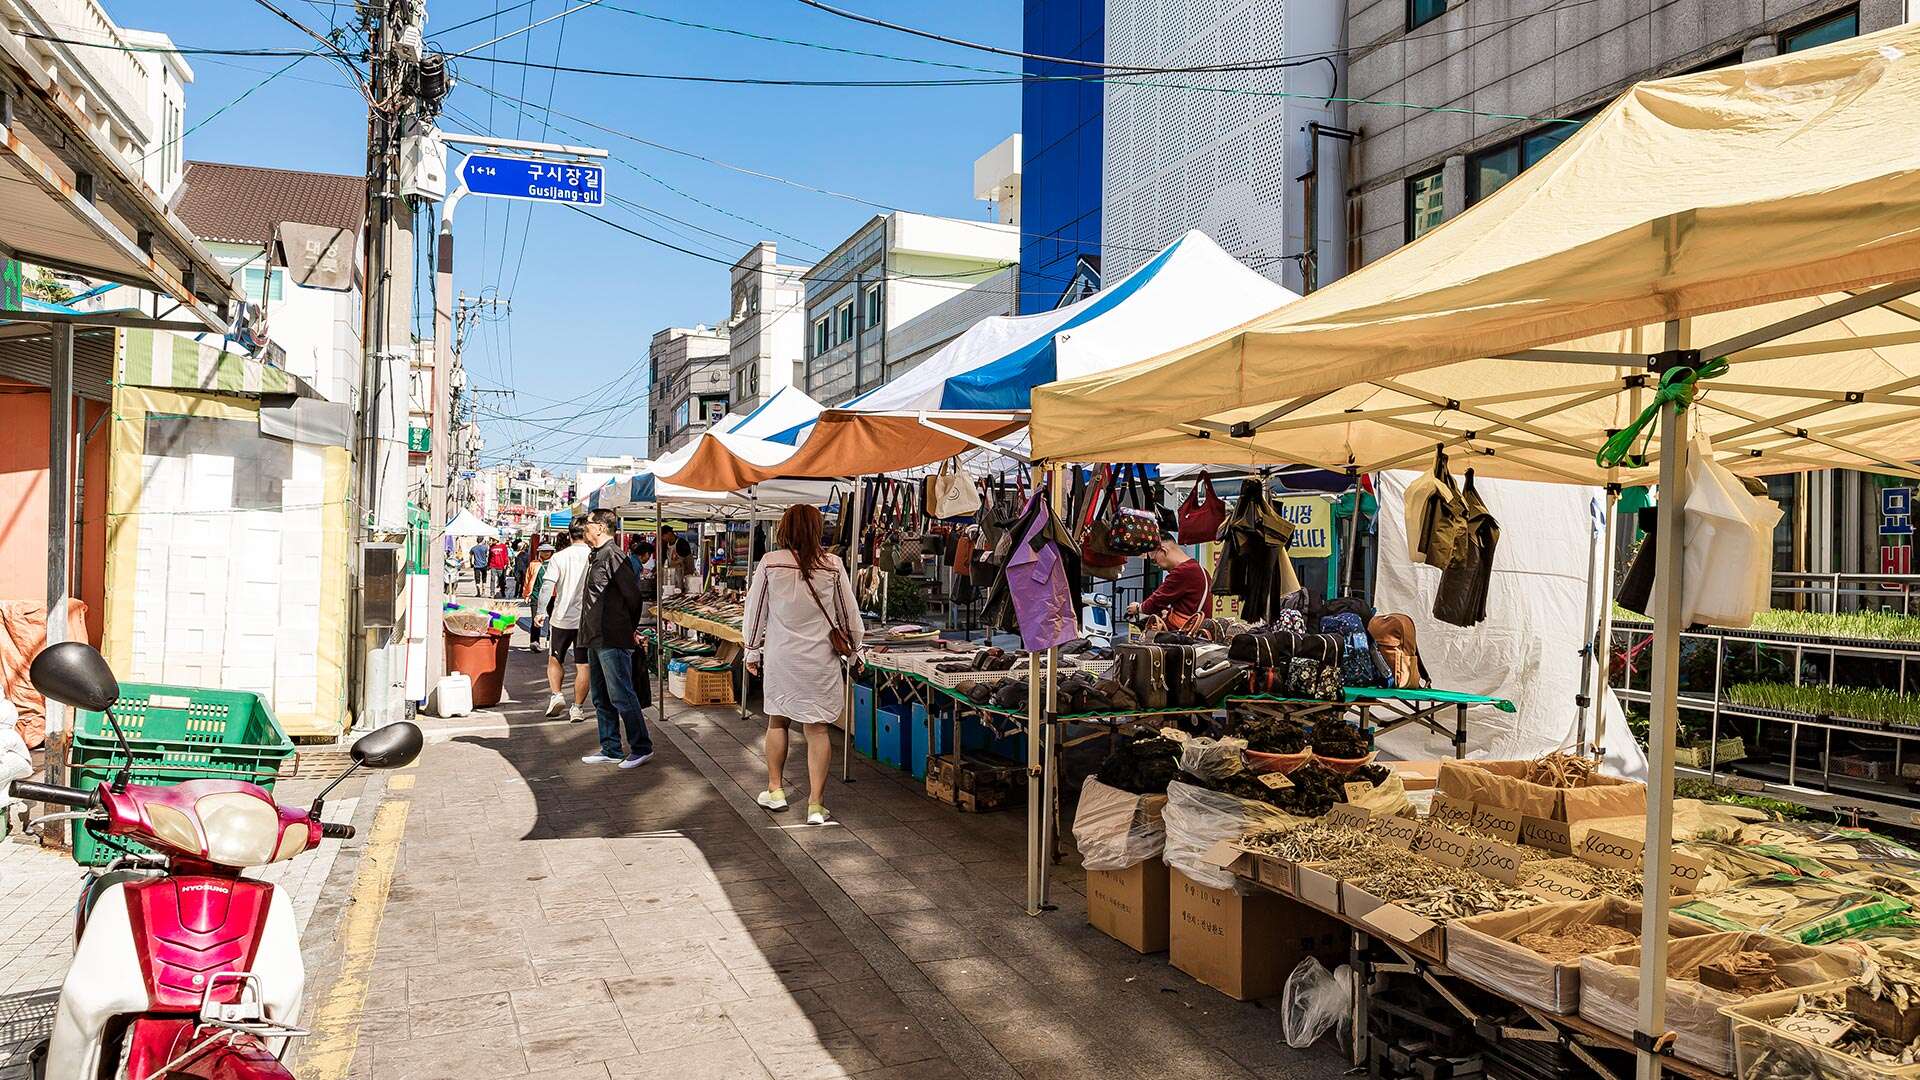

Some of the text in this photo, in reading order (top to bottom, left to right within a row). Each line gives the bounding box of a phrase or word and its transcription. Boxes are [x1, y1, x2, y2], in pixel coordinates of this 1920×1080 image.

[485, 166, 496, 176] 14
[528, 164, 599, 188] 구시장길
[528, 184, 599, 203] Gusijang-gil
[1330, 809, 1365, 829] 20000
[1430, 799, 1471, 821] 25000
[1376, 818, 1413, 841] 35000
[1473, 811, 1516, 833] 35000
[1471, 845, 1515, 871] 35000
[182, 884, 229, 894] HYOSUNG
[1786, 1021, 1830, 1034] 6000
